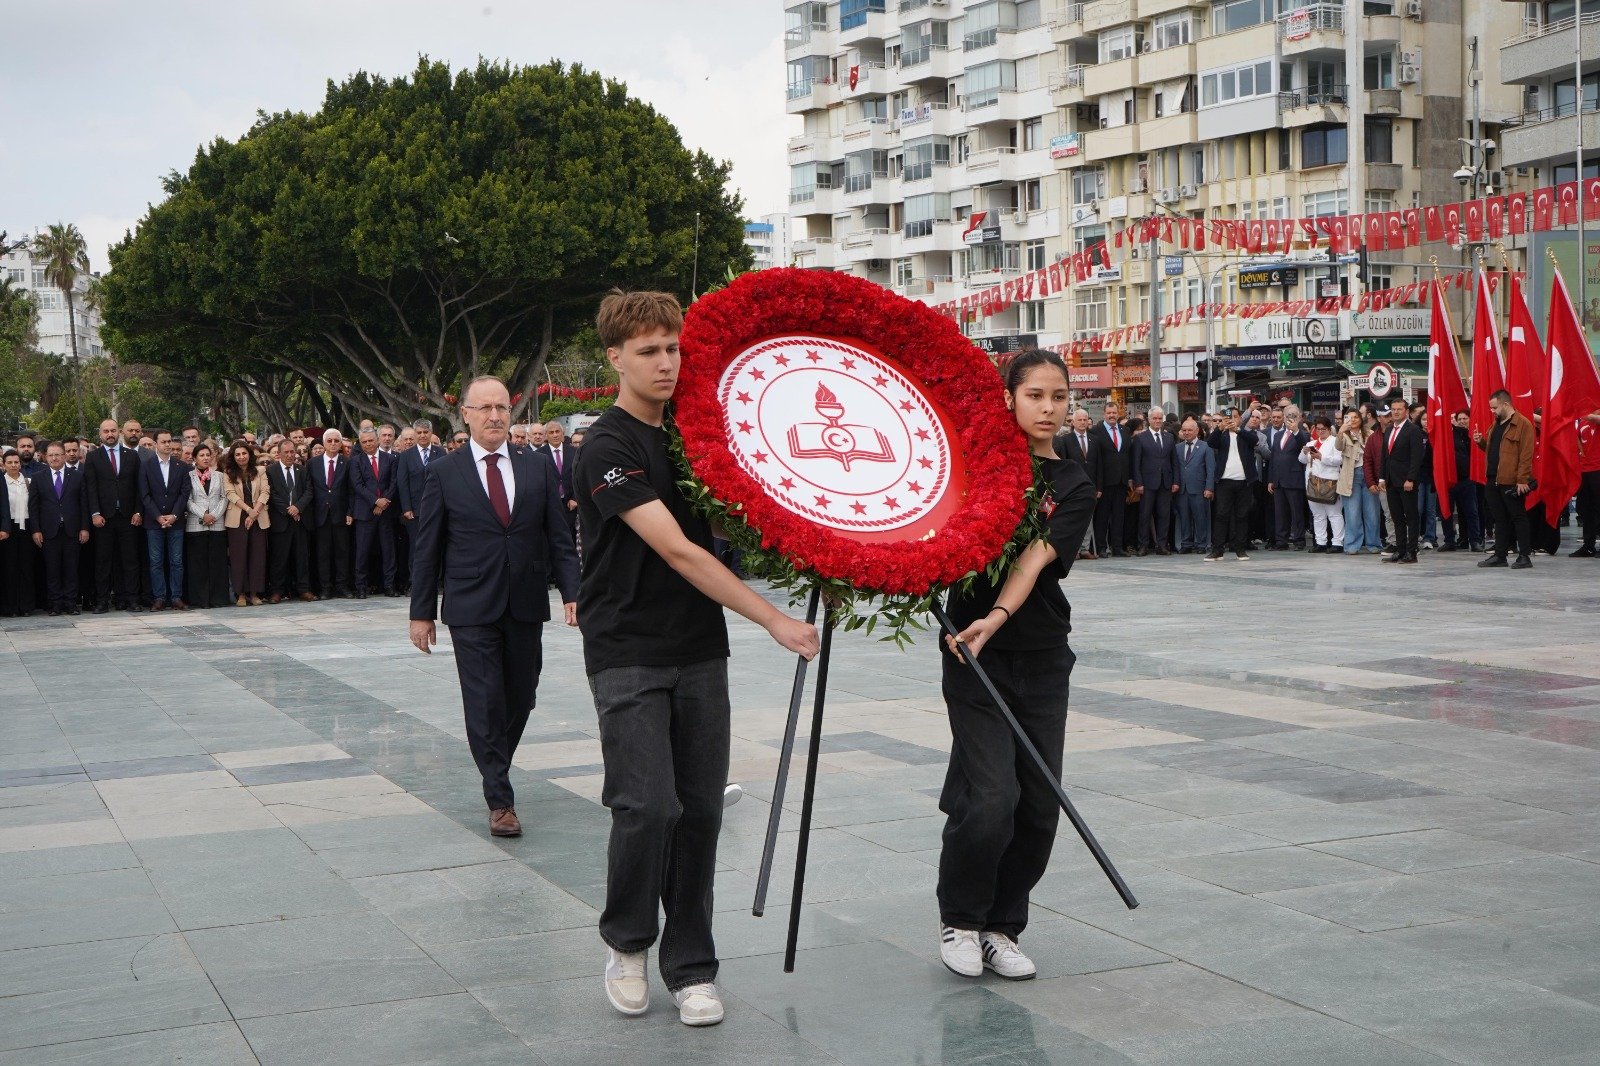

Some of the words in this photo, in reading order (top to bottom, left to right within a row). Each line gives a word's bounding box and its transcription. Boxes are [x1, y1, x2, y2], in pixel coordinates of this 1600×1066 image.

[1240, 272, 1269, 284] DÖVME
[1368, 314, 1394, 330] ÖZLEM
[1396, 314, 1423, 330] ÖZGÜN
[1391, 345, 1411, 353] KENT
